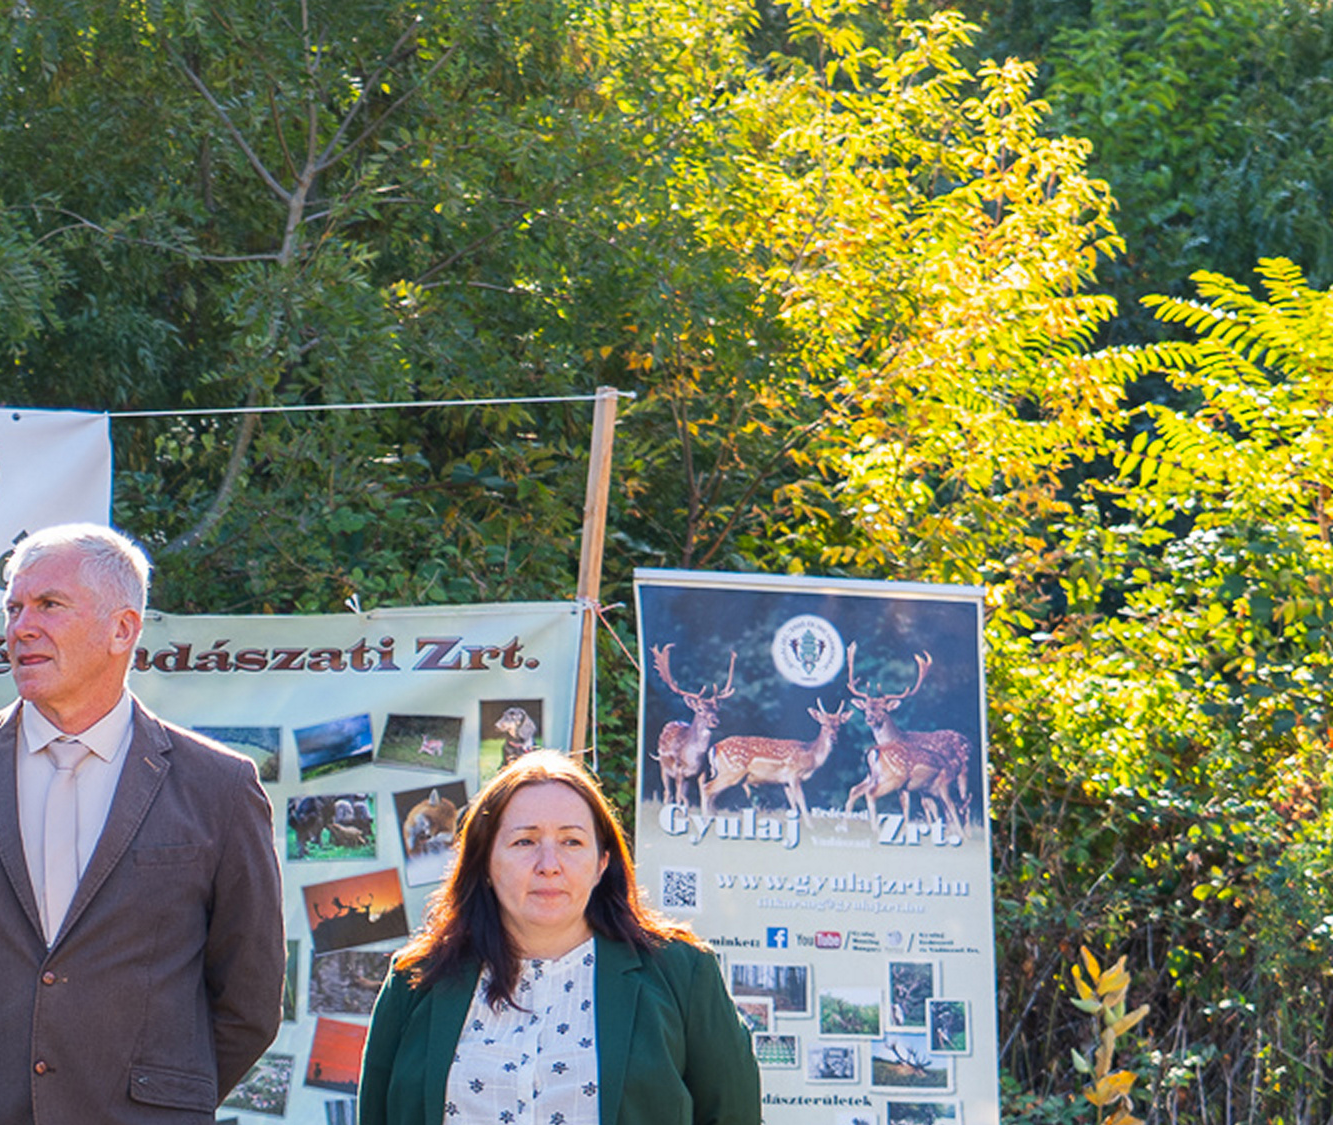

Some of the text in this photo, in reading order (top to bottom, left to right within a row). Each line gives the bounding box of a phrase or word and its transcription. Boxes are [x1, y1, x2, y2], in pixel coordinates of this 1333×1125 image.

[131, 636, 400, 672] adászati
[414, 636, 540, 672] Zrt.
[659, 803, 963, 849] Gyulaj Zrt.
[716, 872, 970, 899] www.gyulajzrt.hu
[762, 1093, 872, 1106] dászterületek
